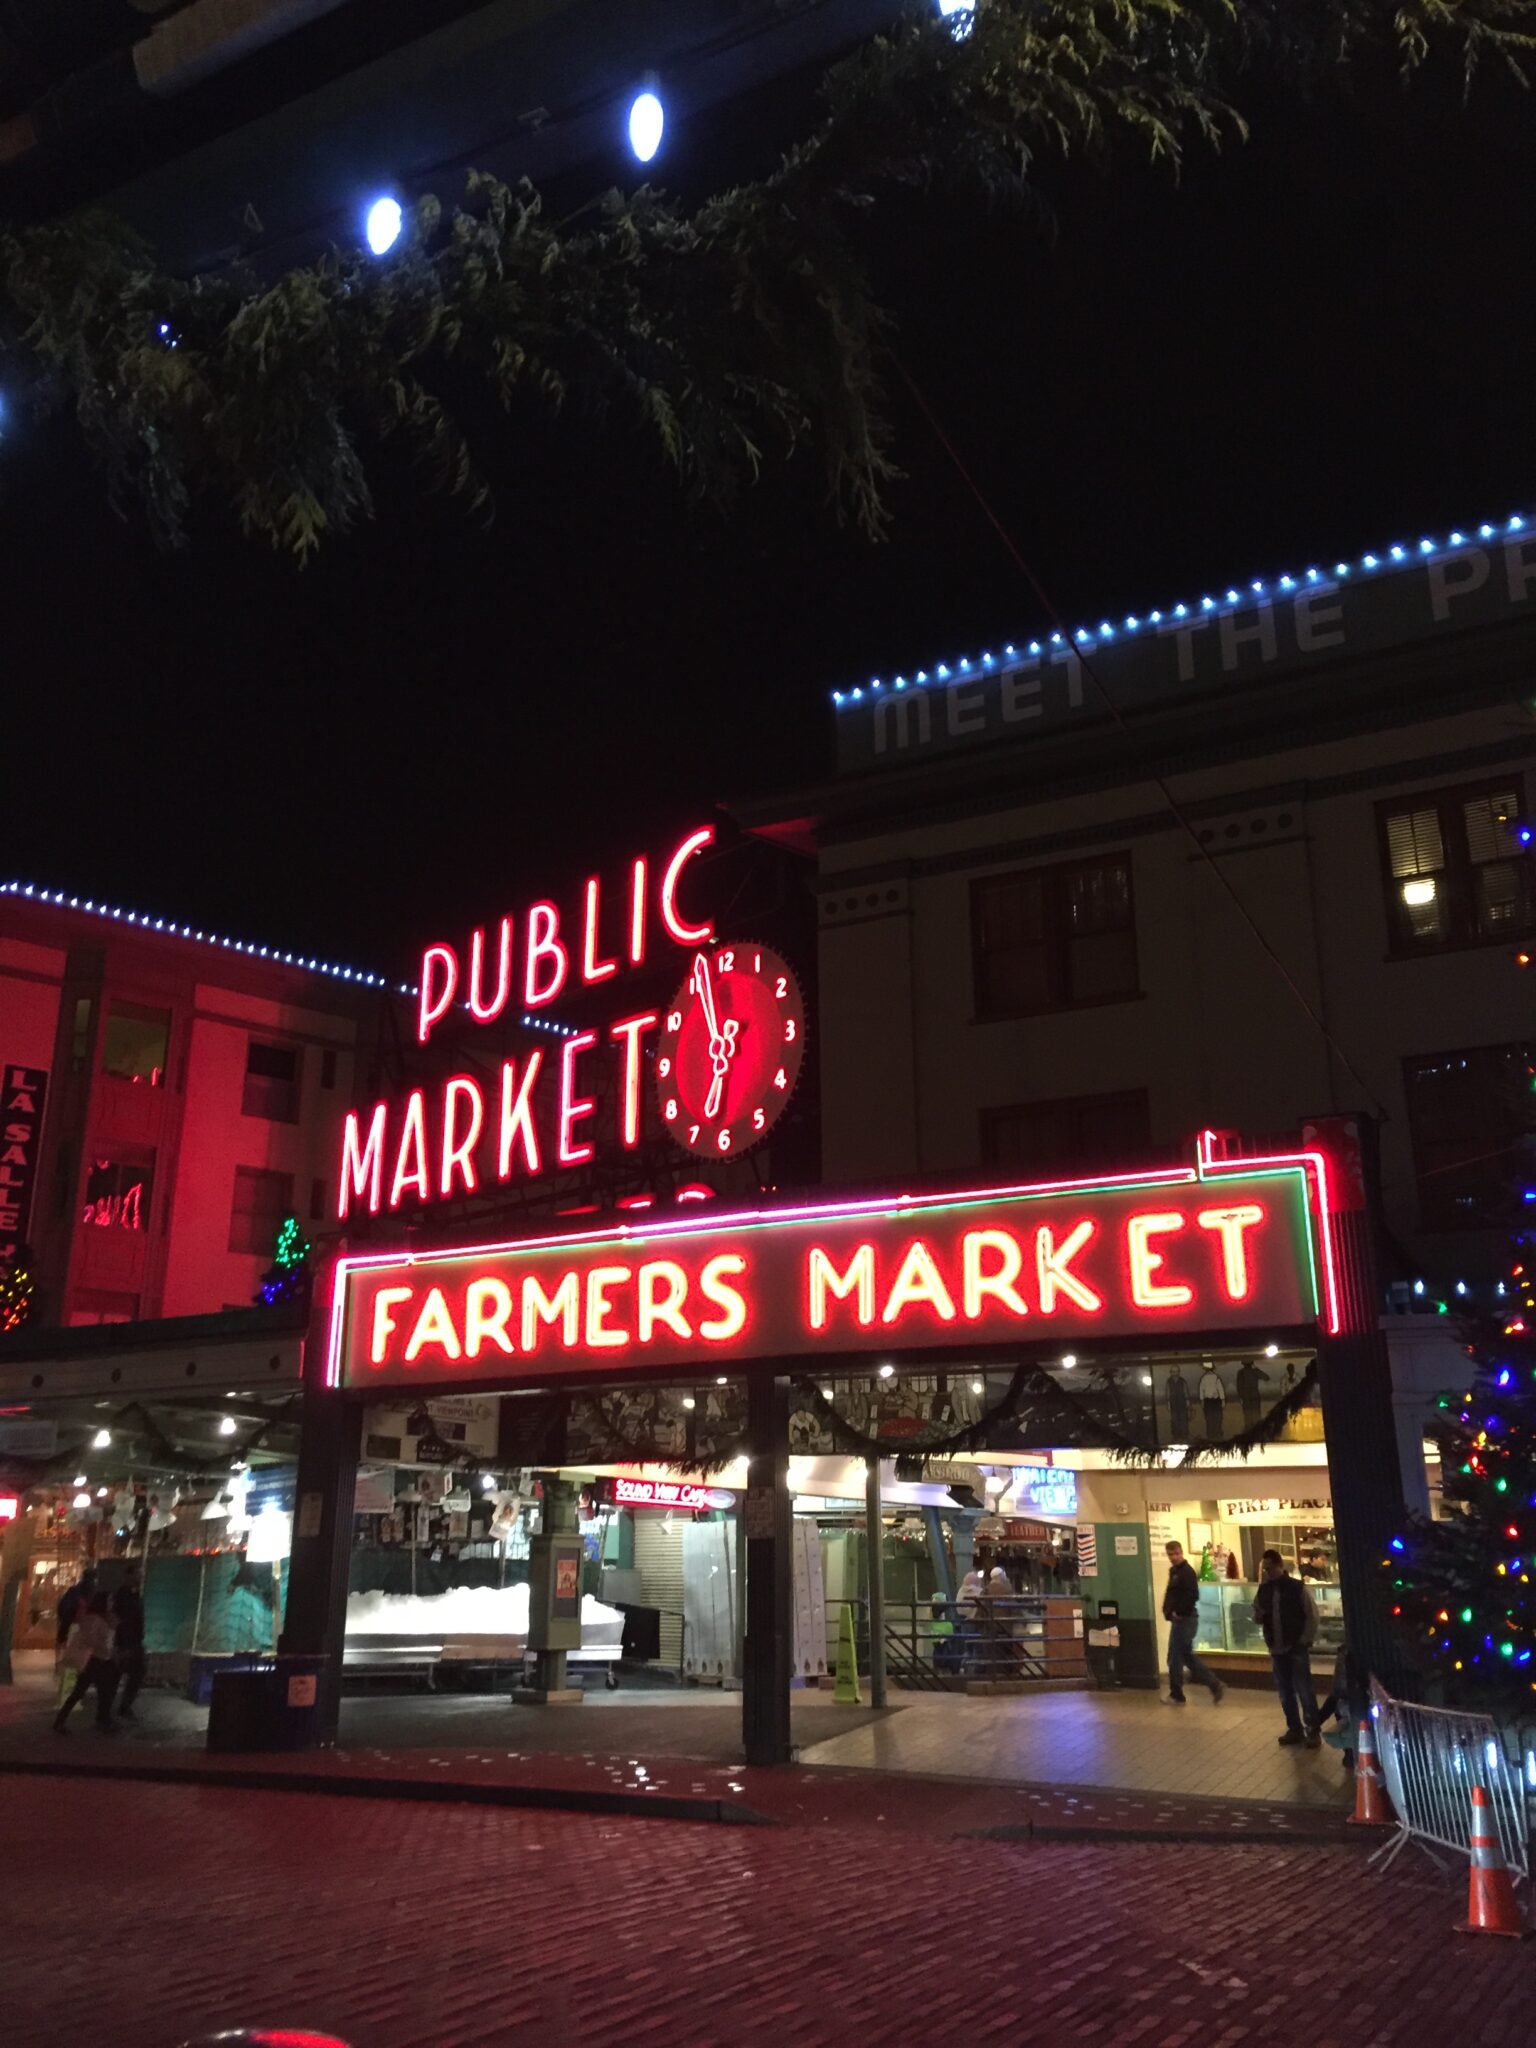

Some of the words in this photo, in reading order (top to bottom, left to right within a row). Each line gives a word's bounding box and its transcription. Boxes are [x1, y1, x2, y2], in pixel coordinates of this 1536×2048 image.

[873, 642, 1098, 755] MEET
[1156, 581, 1346, 681] THE
[417, 826, 714, 1042] PUBLIC
[719, 952, 734, 972] 12
[755, 954, 761, 973] 1
[775, 977, 787, 998] 2
[667, 1012, 682, 1032] 10
[785, 1020, 796, 1041] 3
[659, 1058, 671, 1078] 9
[774, 1069, 787, 1089] 4
[7, 1069, 37, 1114] LA
[338, 1014, 657, 1219] MARKET
[665, 1099, 678, 1119] 8
[753, 1108, 765, 1129] 5
[689, 1125, 700, 1143] 7
[717, 1129, 730, 1150] 6
[0, 1122, 33, 1232] SALLE
[371, 1253, 747, 1363] FARMERS
[809, 1206, 1263, 1328] MARKET
[616, 1479, 653, 1499] SOUND
[655, 1482, 680, 1501] VIEW
[1148, 1502, 1172, 1512] KERY
[1226, 1499, 1270, 1516] PIKE
[1010, 1524, 1045, 1537] LEATHER
